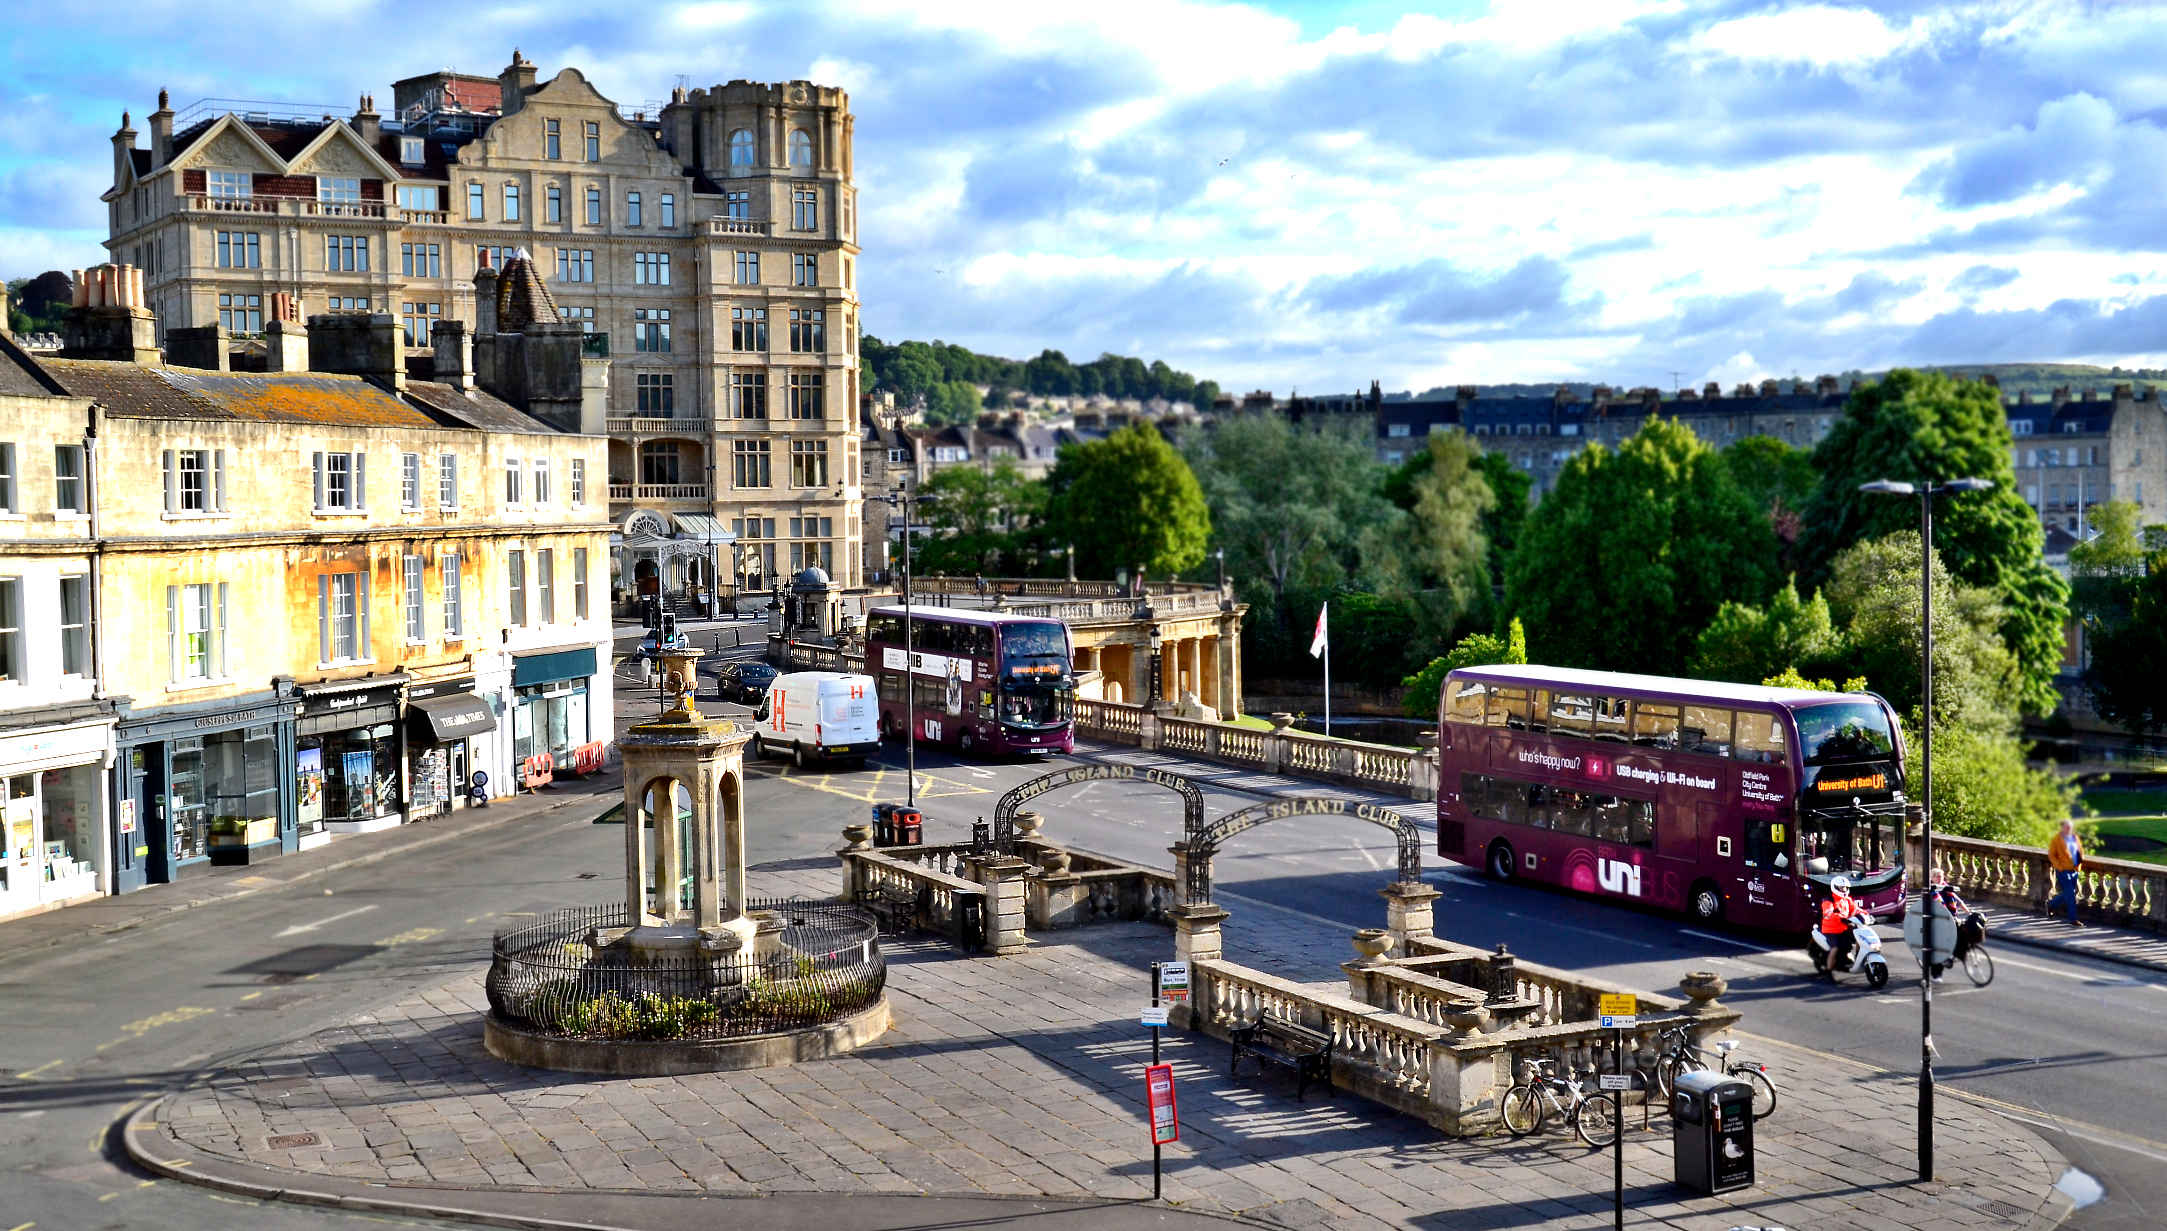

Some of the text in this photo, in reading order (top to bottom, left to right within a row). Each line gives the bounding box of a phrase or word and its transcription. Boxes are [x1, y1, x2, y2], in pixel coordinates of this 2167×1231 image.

[850, 685, 863, 699] H
[772, 688, 786, 733] H
[1539, 752, 1561, 771] happy
[1561, 756, 1581, 770] now?
[1069, 766, 1134, 783] ISLAND
[1146, 769, 1186, 791] CLUB
[1616, 765, 1631, 777] USB
[1631, 766, 1659, 784] charging
[1686, 777, 1695, 787] on
[1695, 777, 1716, 790] board
[1817, 779, 1849, 791] University
[1850, 777, 1858, 788] of
[1858, 777, 1872, 788] Bath
[1742, 789, 1765, 801] University
[1212, 800, 1400, 839] THE ISLAND CLUB
[1604, 1017, 1612, 1026] P
